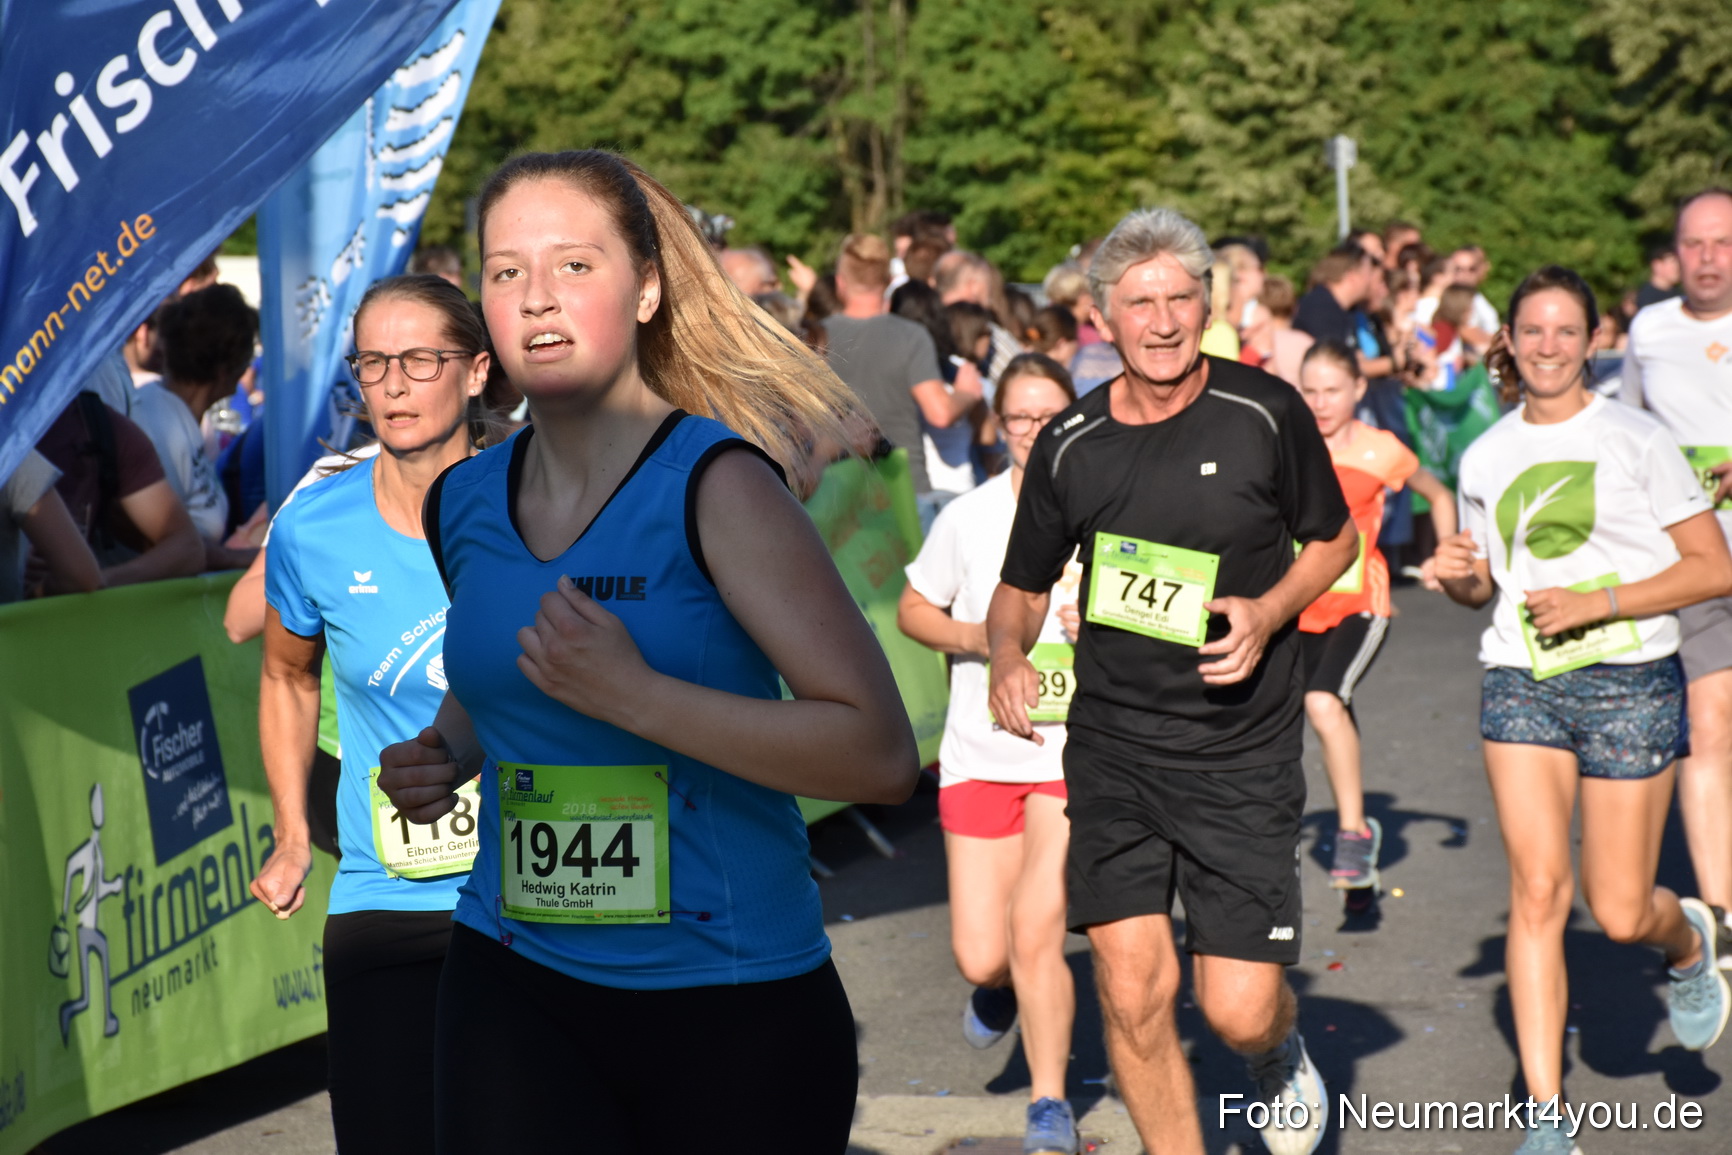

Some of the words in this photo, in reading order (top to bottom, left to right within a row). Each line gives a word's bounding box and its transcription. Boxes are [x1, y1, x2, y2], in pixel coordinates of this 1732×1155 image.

[348, 584, 379, 594] erima
[1120, 570, 1183, 612] 747
[1124, 604, 1153, 619] Dengel
[1155, 613, 1169, 623] Edi
[367, 646, 403, 687] Team
[152, 720, 204, 768] Fischer
[562, 803, 598, 816] 2018
[407, 844, 444, 858] Eibner
[511, 820, 640, 878] 1944
[414, 856, 437, 866] Schick
[521, 880, 566, 898] Hedwig
[570, 882, 616, 896] Katrin
[536, 898, 560, 908] Thule
[562, 899, 594, 908] GmbH
[1268, 926, 1294, 940] JAKO
[132, 937, 219, 1017] neumarkt
